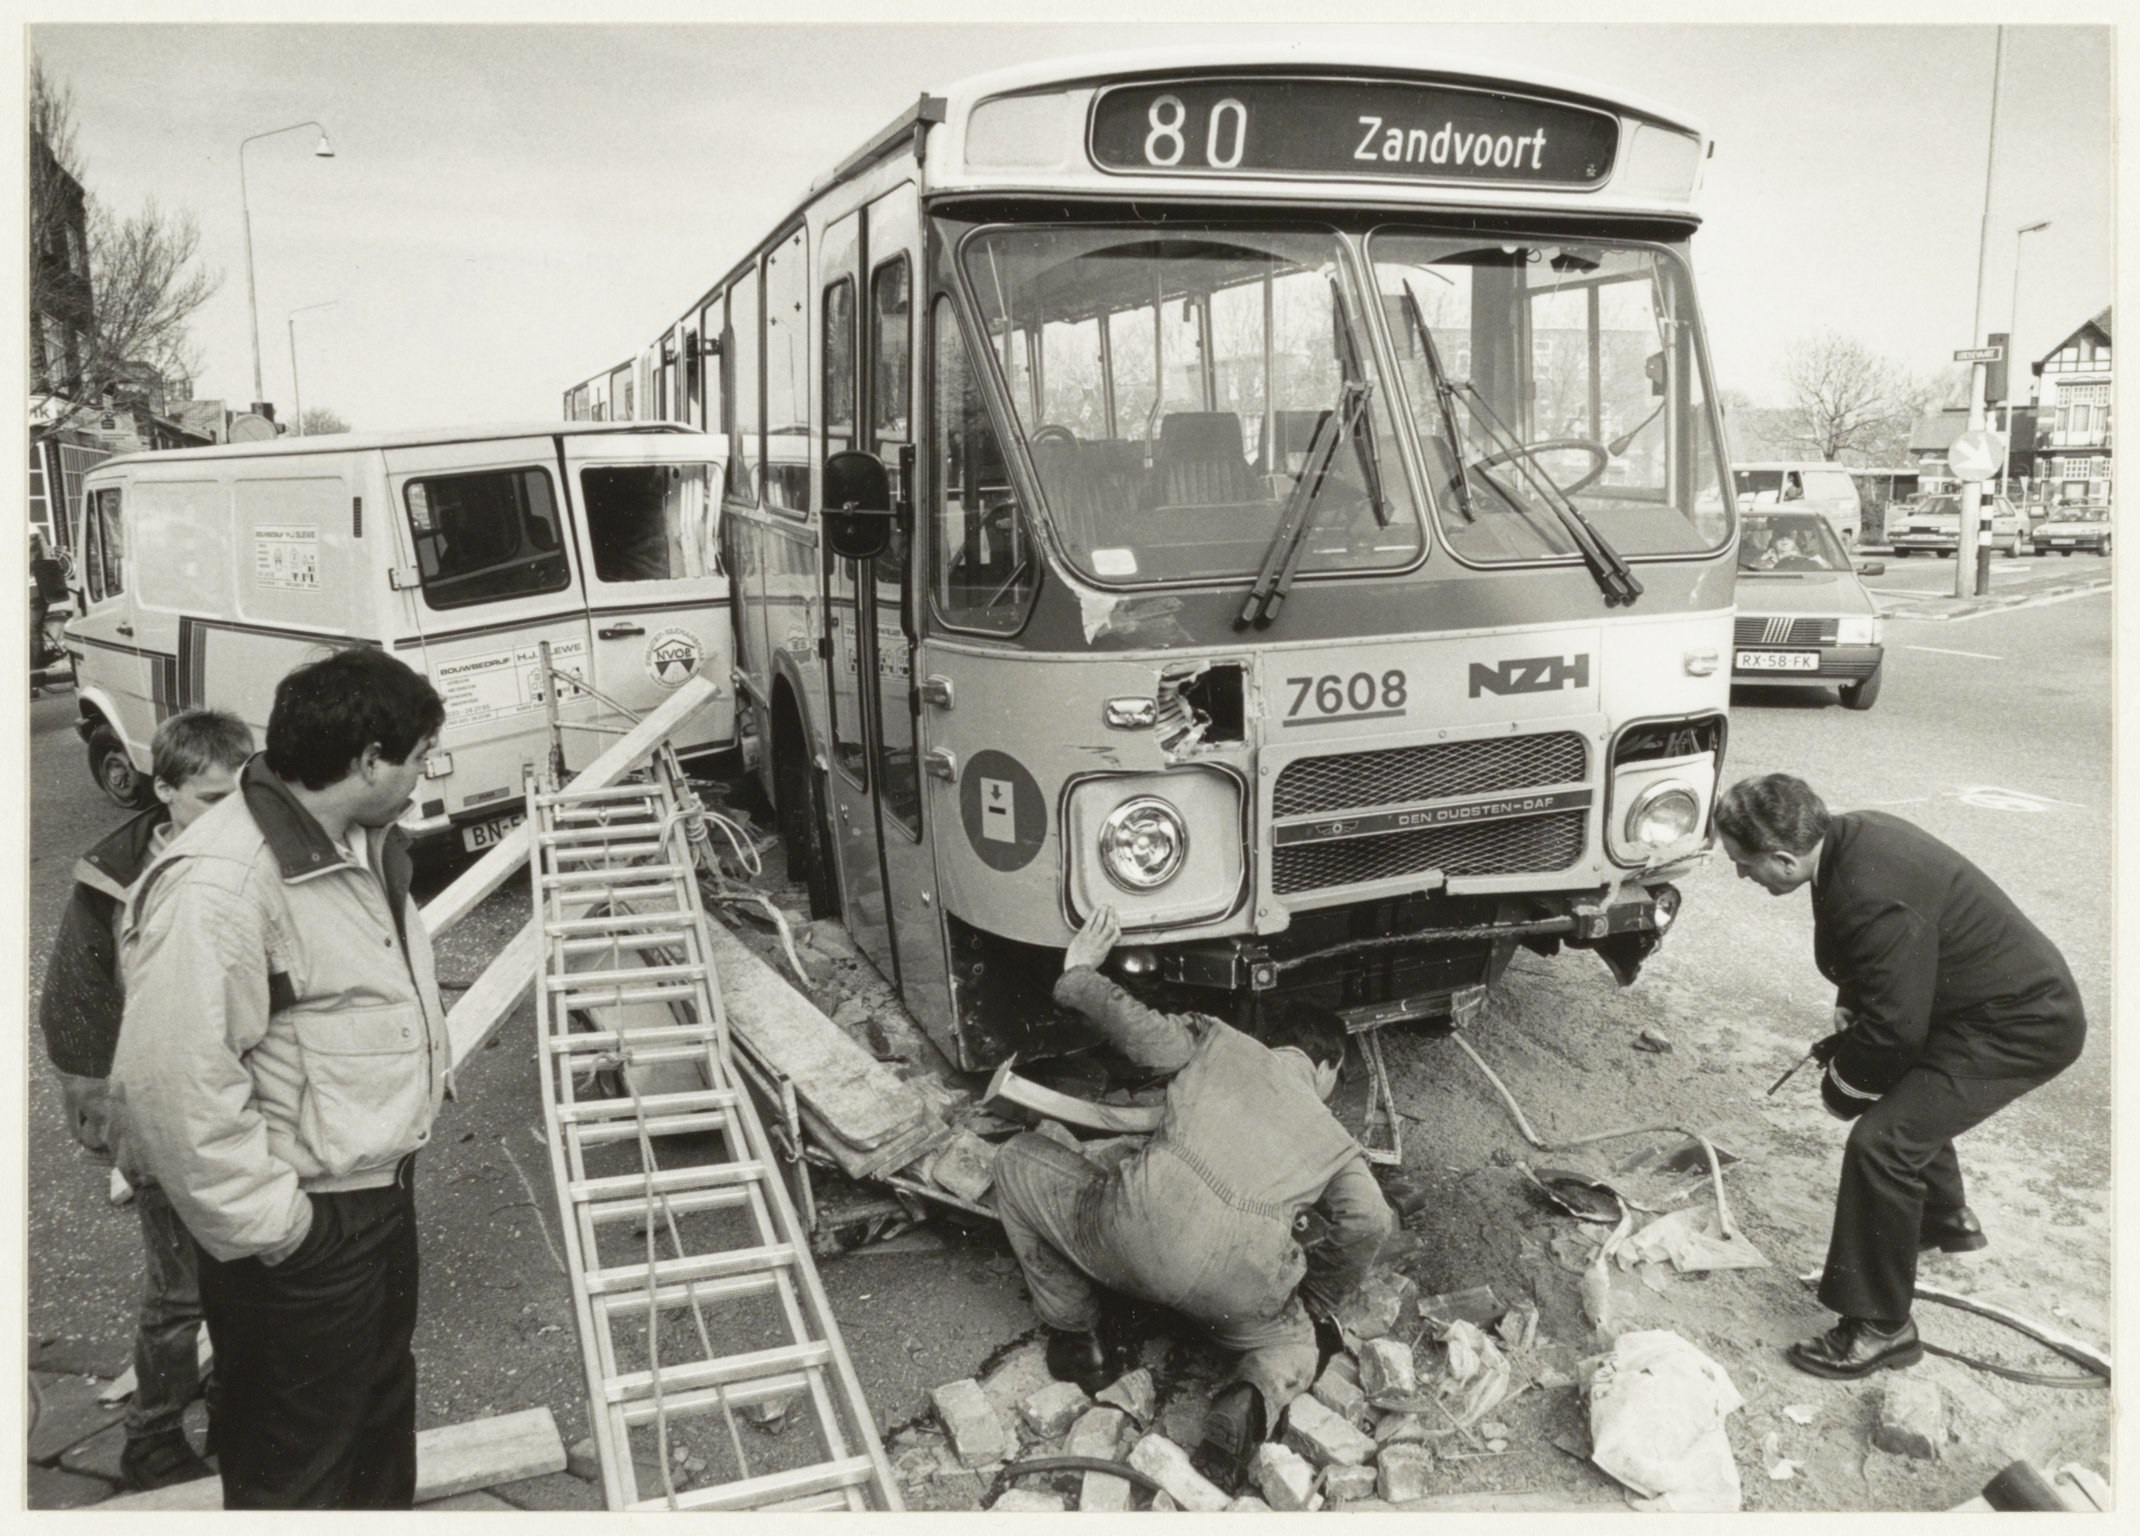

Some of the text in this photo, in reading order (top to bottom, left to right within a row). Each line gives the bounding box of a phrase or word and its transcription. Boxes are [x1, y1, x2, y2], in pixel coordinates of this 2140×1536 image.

[1145, 95, 1546, 169] 80 Zandvoort
[440, 657, 510, 676] BOUWBEDRIJF
[656, 647, 692, 661] NVOB
[1742, 654, 1812, 669] RX-58-FK
[1469, 653, 1589, 698] NZH
[1286, 669, 1407, 717] 7608
[1398, 797, 1555, 826] DEN OUDSTEN-DAF
